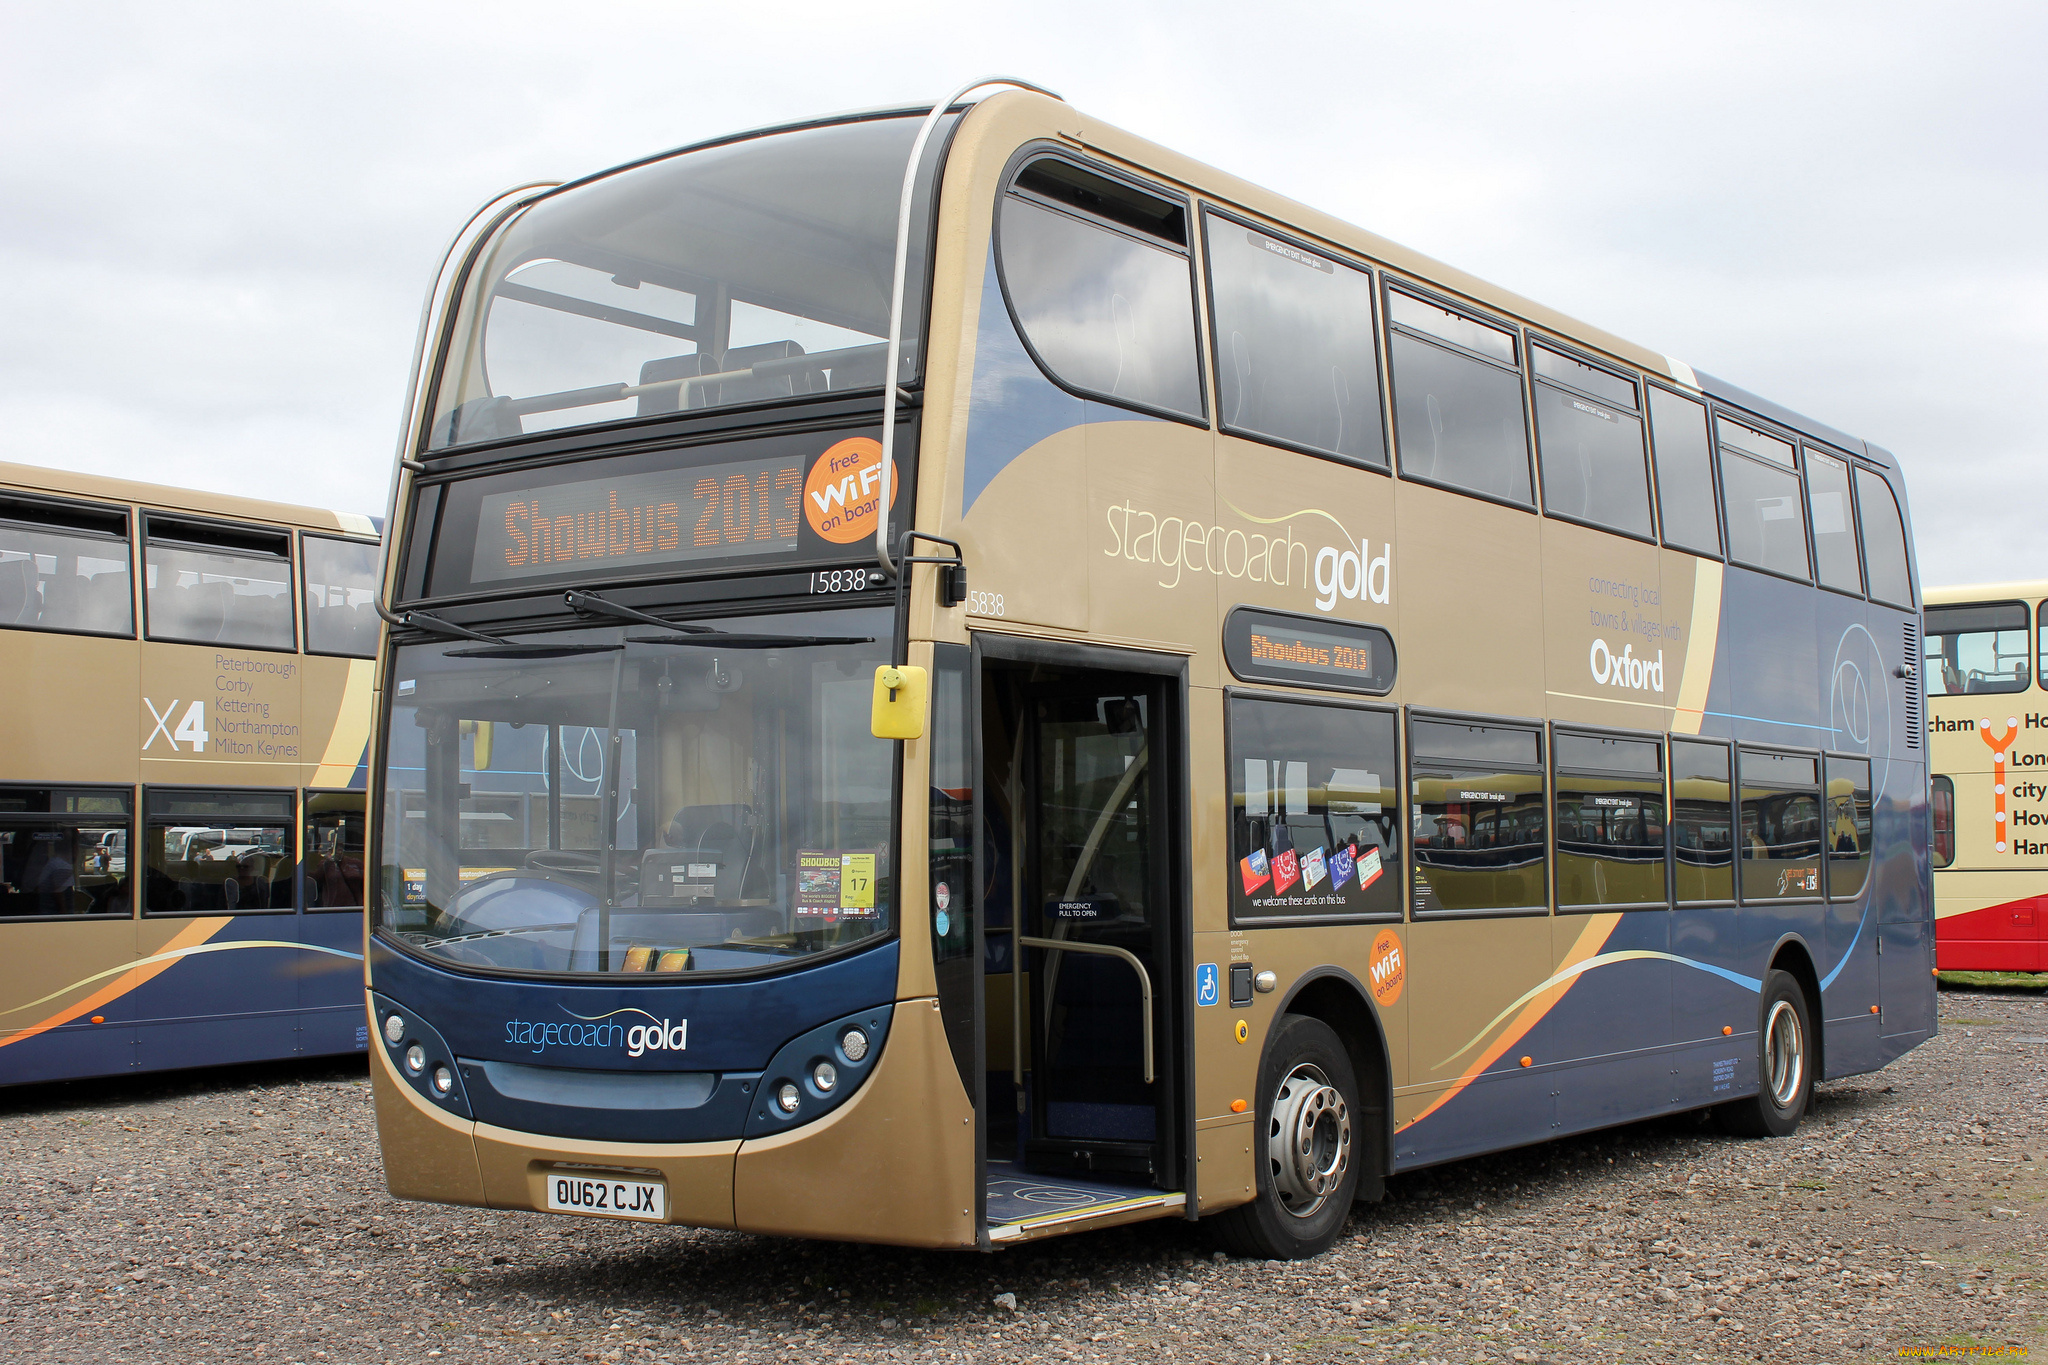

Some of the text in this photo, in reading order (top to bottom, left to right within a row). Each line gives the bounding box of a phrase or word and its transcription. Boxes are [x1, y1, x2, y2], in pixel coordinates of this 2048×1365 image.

[829, 453, 860, 473] free
[505, 467, 801, 566] Showbus 2013
[821, 498, 880, 531] on boar
[1104, 499, 1391, 612] stagecoach gold
[810, 568, 866, 594] 15838
[1589, 577, 1660, 608] connecting local
[1590, 607, 1682, 642] towns & villages with
[1251, 634, 1367, 670] Showbus 2013
[216, 654, 297, 679] Peterborough
[1590, 638, 1664, 692] Oxford
[216, 675, 254, 696] Corby
[216, 696, 270, 718] Kettering
[142, 698, 209, 752] X4
[216, 717, 298, 739] Northampton
[216, 738, 298, 759] Milton Keynes
[2012, 751, 2048, 766] Lon
[2012, 781, 2047, 802] city
[800, 858, 840, 866] SHOWBUS
[412, 883, 422, 892] day
[850, 878, 868, 891] 17
[1252, 894, 1346, 907] we welcome these cards on this bus
[1230, 930, 1244, 938] DOOR
[1377, 940, 1389, 954] free
[1370, 948, 1400, 984] WiFi
[1377, 969, 1402, 998] on board
[505, 1018, 688, 1057] stagecoach gold
[557, 1180, 656, 1212] OU62 CJX
